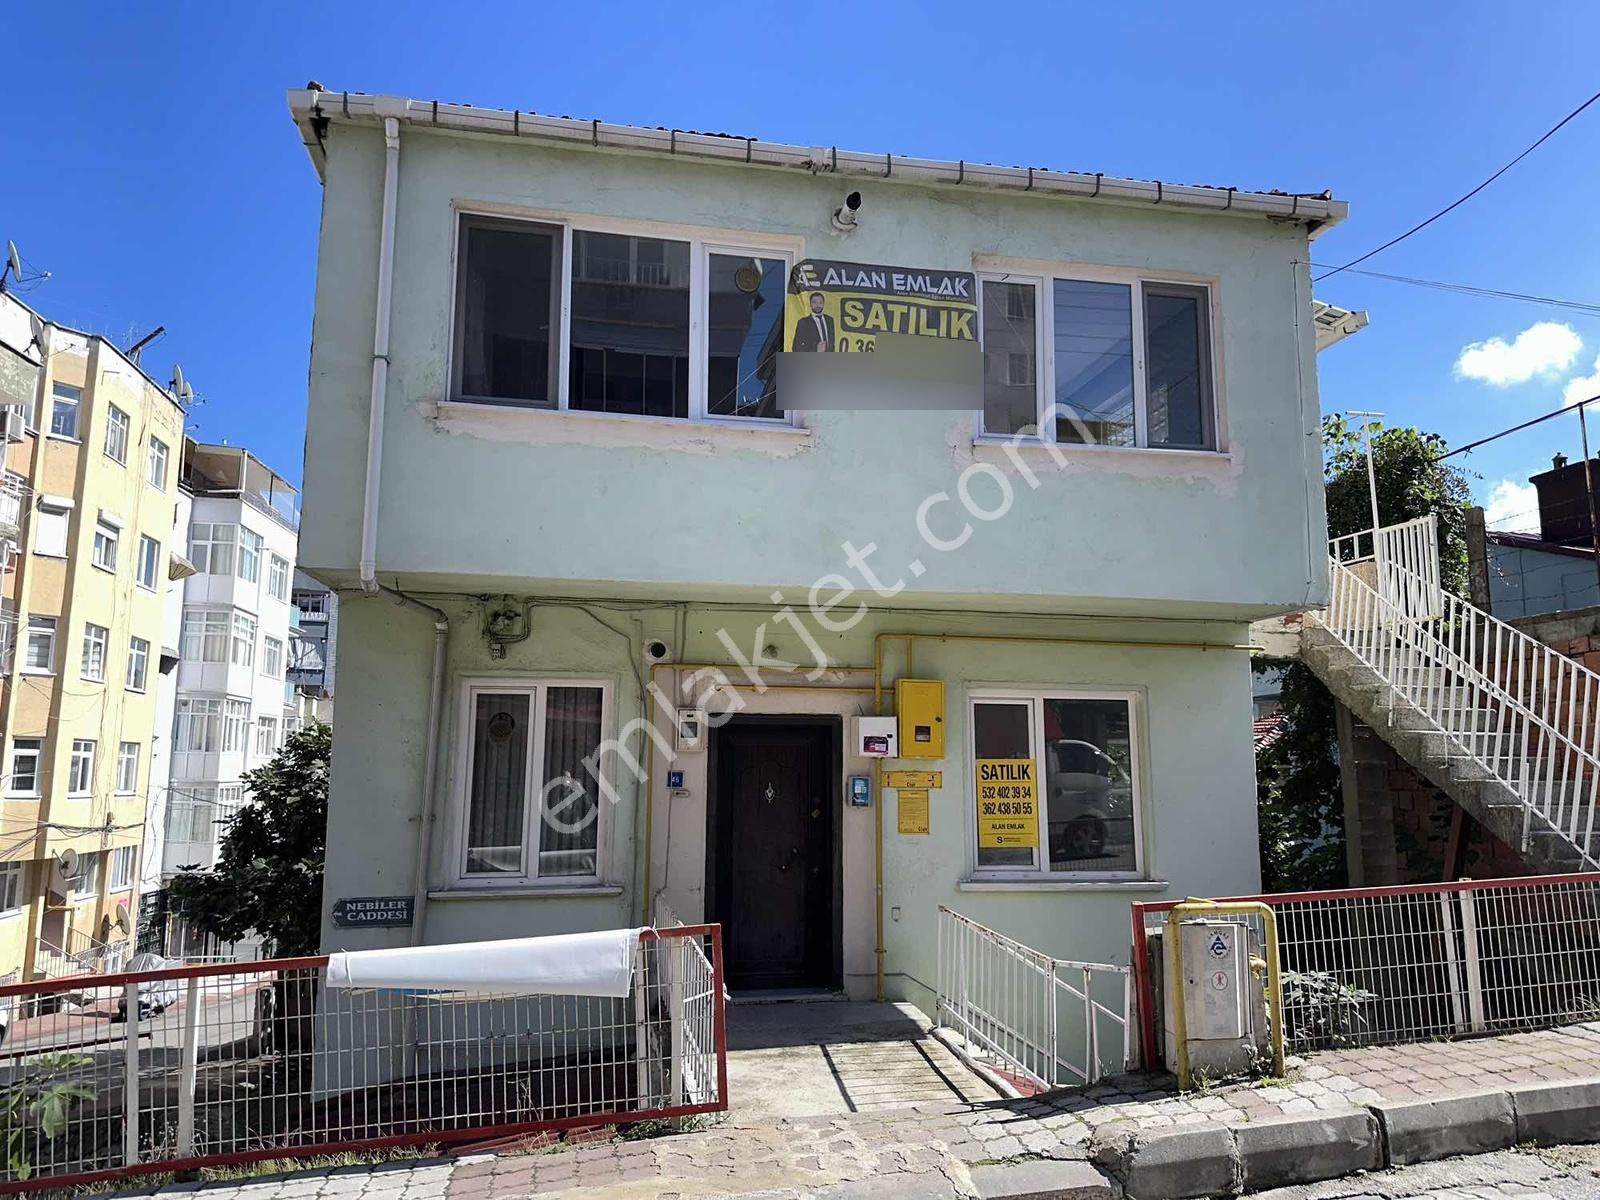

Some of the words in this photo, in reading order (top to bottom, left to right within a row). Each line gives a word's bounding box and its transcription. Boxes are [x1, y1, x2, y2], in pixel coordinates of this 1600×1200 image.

[823, 267, 886, 289] ALAN
[892, 273, 969, 297] EMLAK
[844, 300, 974, 340] SATILIK
[981, 764, 1031, 780] SATILIK
[982, 786, 996, 799] 532
[997, 786, 1010, 799] 402
[1011, 786, 1021, 799] 39
[1021, 786, 1031, 799] 34
[982, 802, 997, 815] 362
[998, 802, 1011, 815] 438
[1012, 802, 1022, 815] 50
[1022, 802, 1033, 815] 55
[346, 900, 408, 911] NEBİLER
[347, 908, 408, 921] CADDESİ
